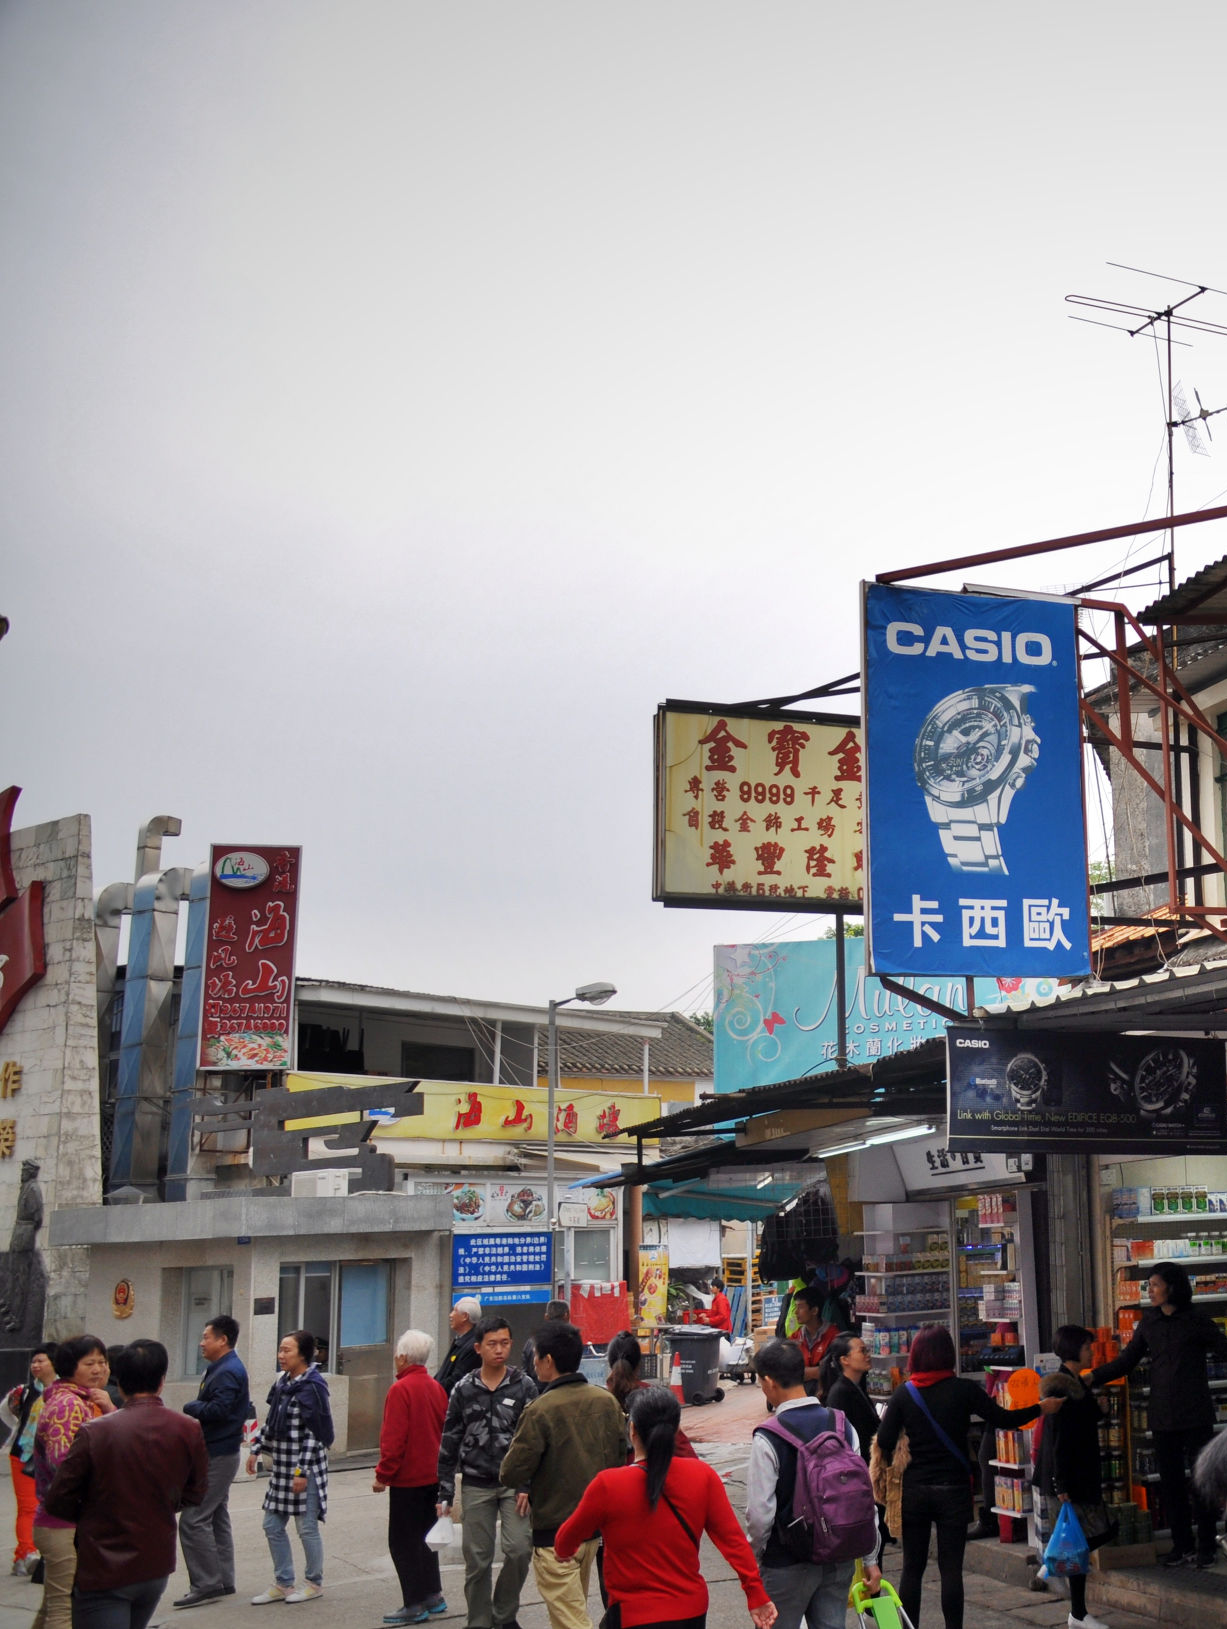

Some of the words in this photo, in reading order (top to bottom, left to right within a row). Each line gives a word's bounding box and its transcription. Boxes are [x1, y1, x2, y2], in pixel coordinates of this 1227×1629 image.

[886, 621, 1052, 666] CASIO
[893, 894, 1073, 951] 卡西歐
[240, 901, 290, 1003] 海山
[956, 1038, 990, 1049] CASIO
[957, 1109, 973, 1120] Link
[975, 1109, 992, 1120] with
[993, 1110, 1022, 1121] Global
[1046, 1112, 1066, 1122] New
